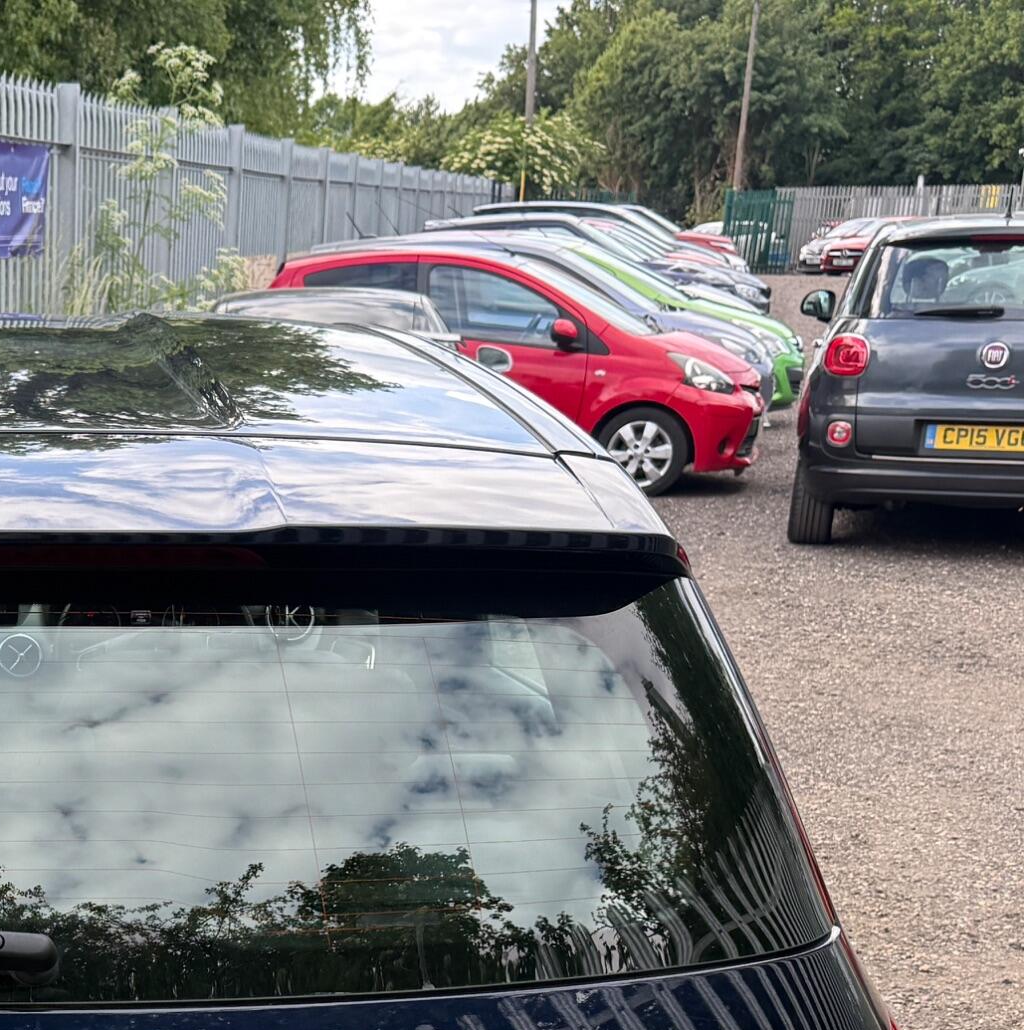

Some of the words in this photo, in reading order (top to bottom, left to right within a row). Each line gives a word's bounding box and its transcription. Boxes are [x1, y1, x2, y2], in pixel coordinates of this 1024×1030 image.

[5, 175, 18, 196] your
[943, 427, 988, 446] CP15
[995, 428, 1024, 446] VG
